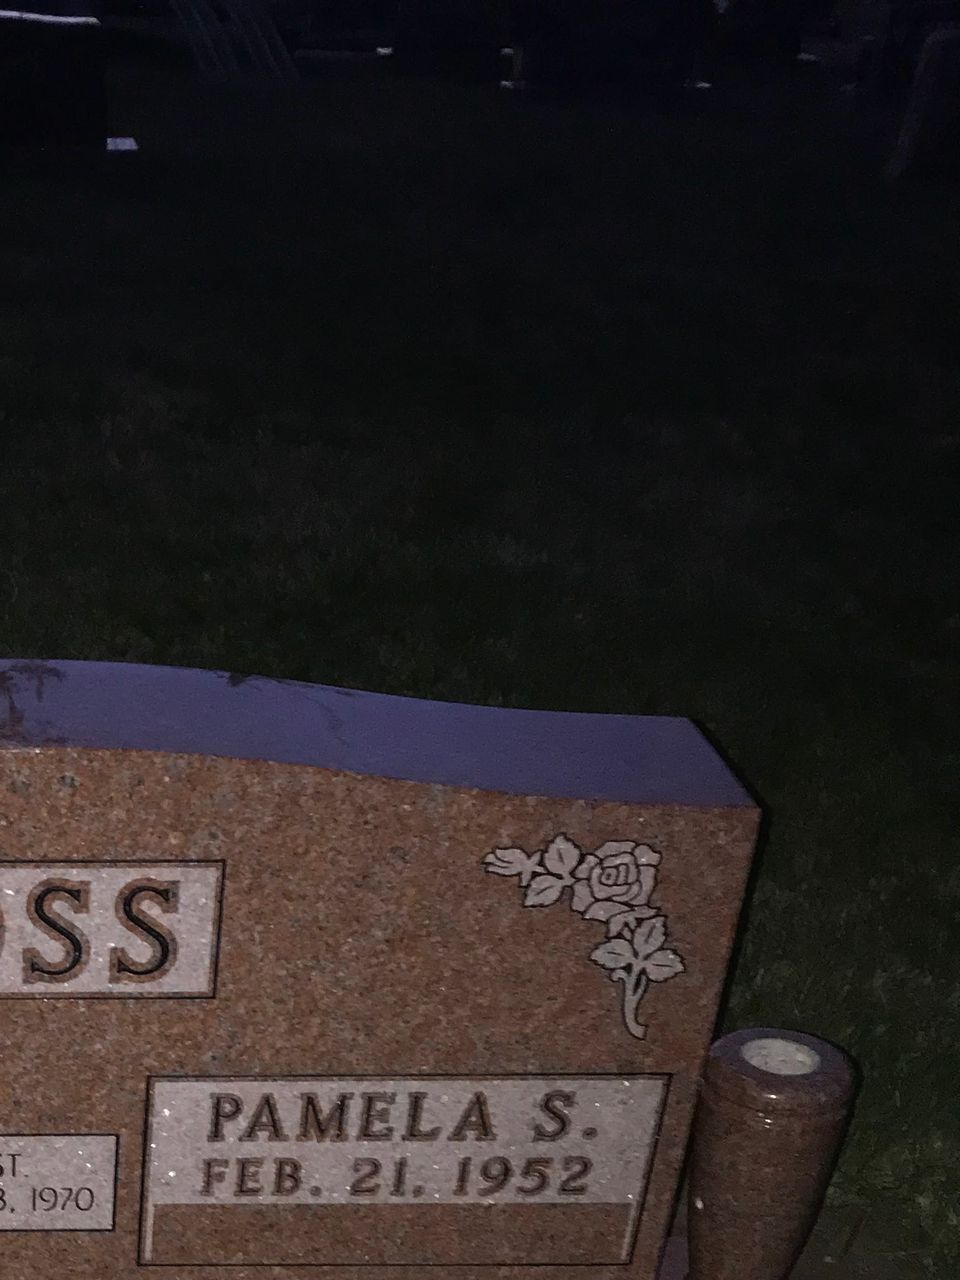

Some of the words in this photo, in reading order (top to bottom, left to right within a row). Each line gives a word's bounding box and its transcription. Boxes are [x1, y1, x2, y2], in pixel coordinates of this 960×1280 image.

[207, 1090, 499, 1143] PAMELA
[532, 1089, 599, 1143] S.
[200, 1157, 322, 1197] FEB.
[452, 1156, 594, 1198] 1952
[31, 1186, 95, 1212] 1970
